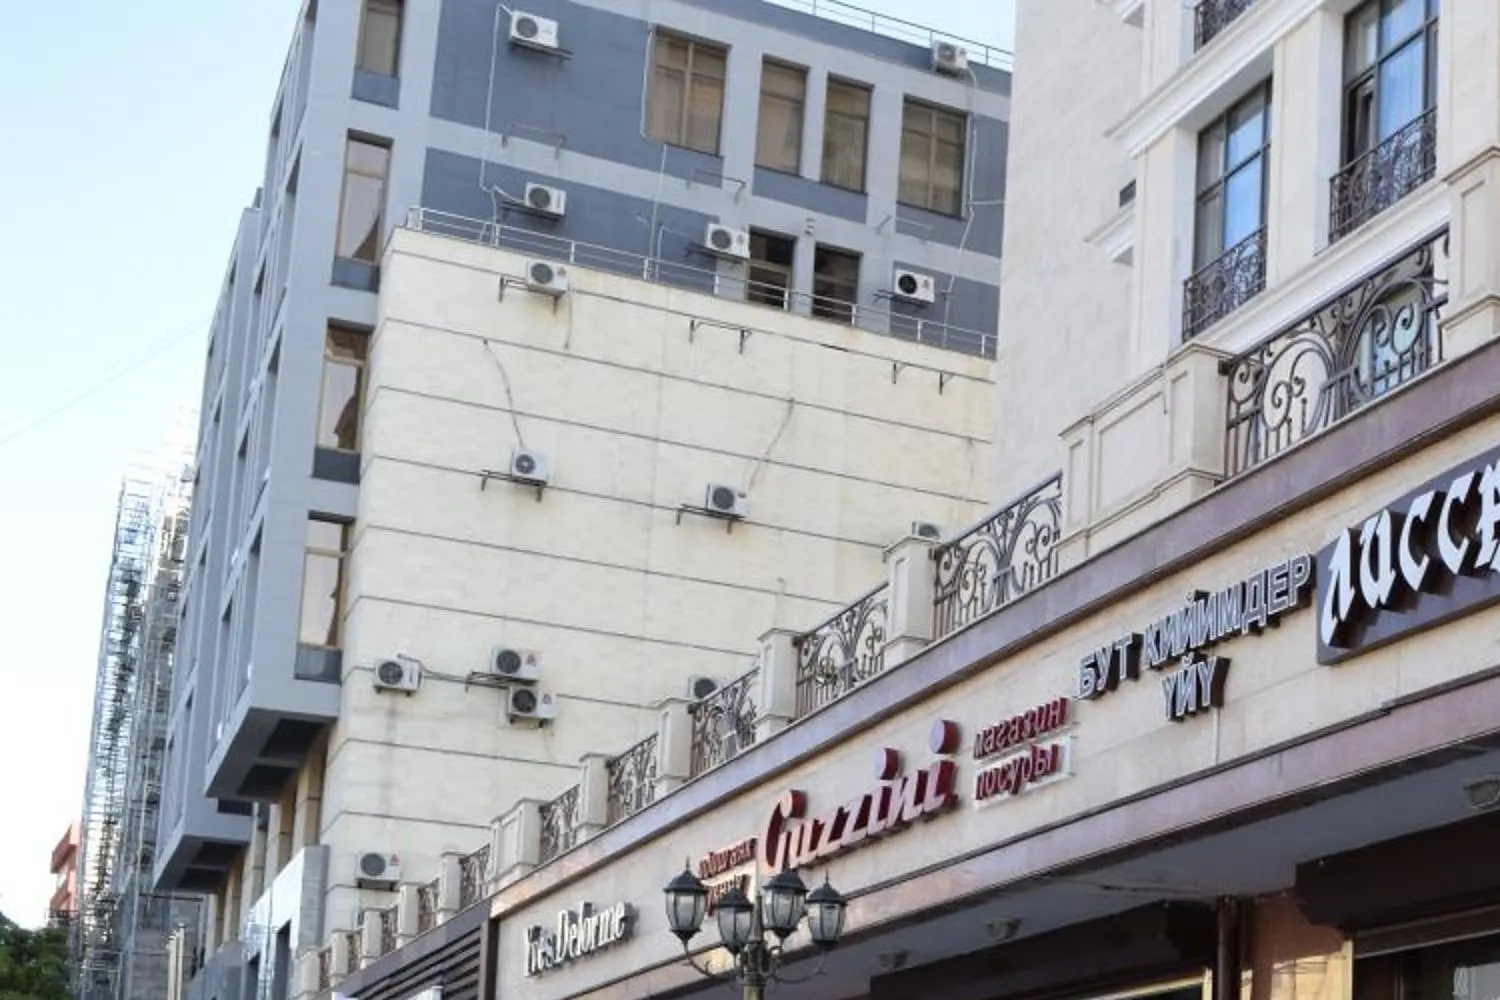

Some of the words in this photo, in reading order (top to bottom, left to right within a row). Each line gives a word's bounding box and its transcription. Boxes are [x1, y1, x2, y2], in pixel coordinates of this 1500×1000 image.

[1077, 634, 1133, 699] БУТ
[1143, 553, 1312, 669] КИЙИМДЕР
[555, 900, 626, 964] Delorme
